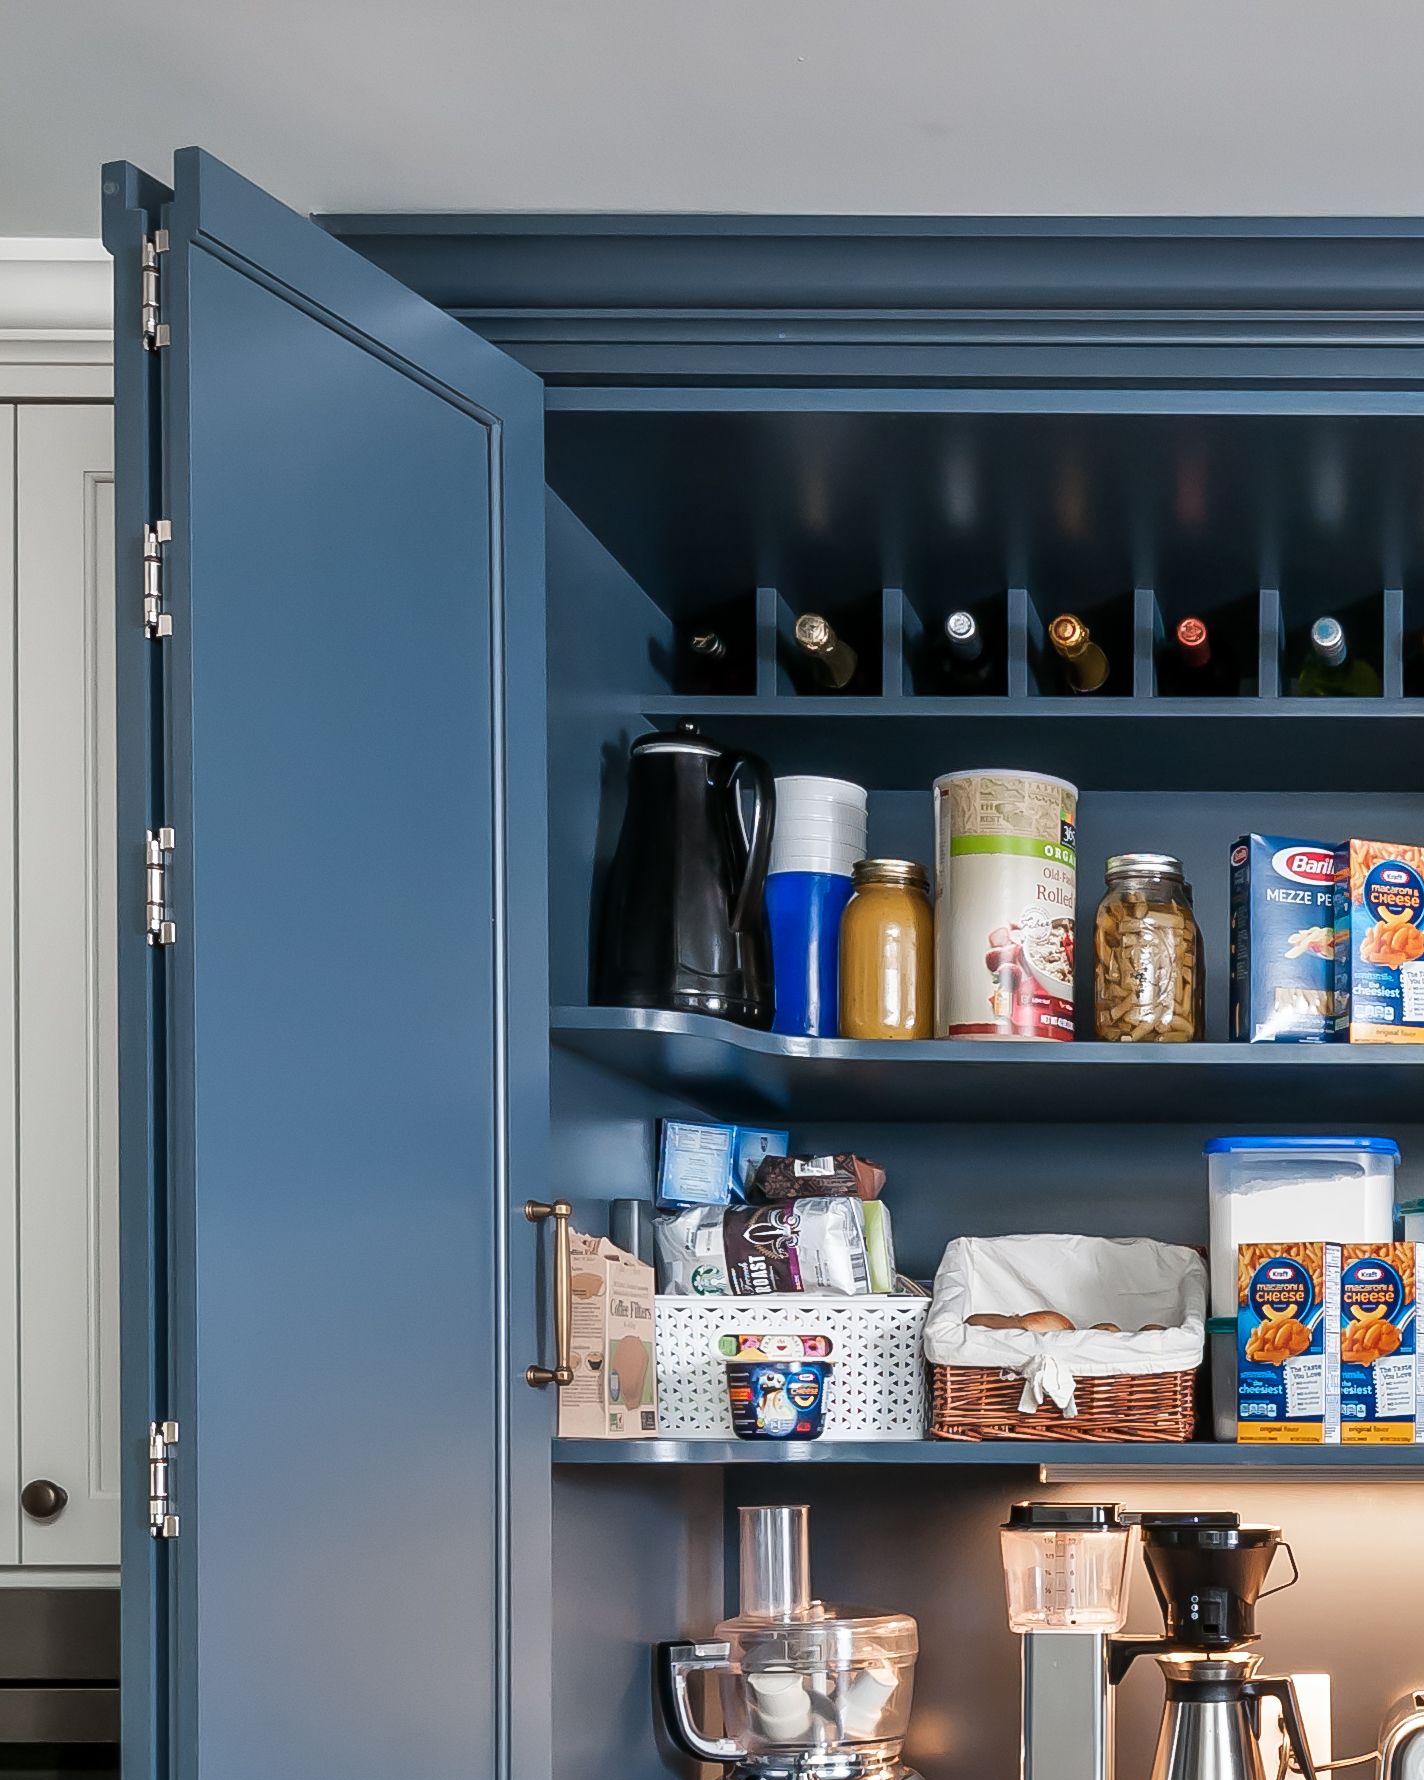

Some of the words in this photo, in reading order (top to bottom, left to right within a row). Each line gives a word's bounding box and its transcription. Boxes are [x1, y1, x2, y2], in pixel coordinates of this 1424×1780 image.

[1036, 883, 1074, 909] Rolled
[1266, 888, 1312, 904] MEZZE
[1317, 893, 1332, 906] PE
[1352, 984, 1400, 998] cheesiest
[748, 1255, 772, 1294] ROAST
[1271, 1270, 1289, 1278] Kraft
[1361, 1270, 1378, 1278] Kraft
[1256, 1283, 1298, 1291] macaroni
[1344, 1283, 1388, 1291] macaroni
[610, 1298, 629, 1318] Coffee
[1239, 1383, 1283, 1394] cheesiest
[1341, 1384, 1373, 1395] esiest
[1260, 1426, 1283, 1434] original
[1348, 1425, 1372, 1434] original
